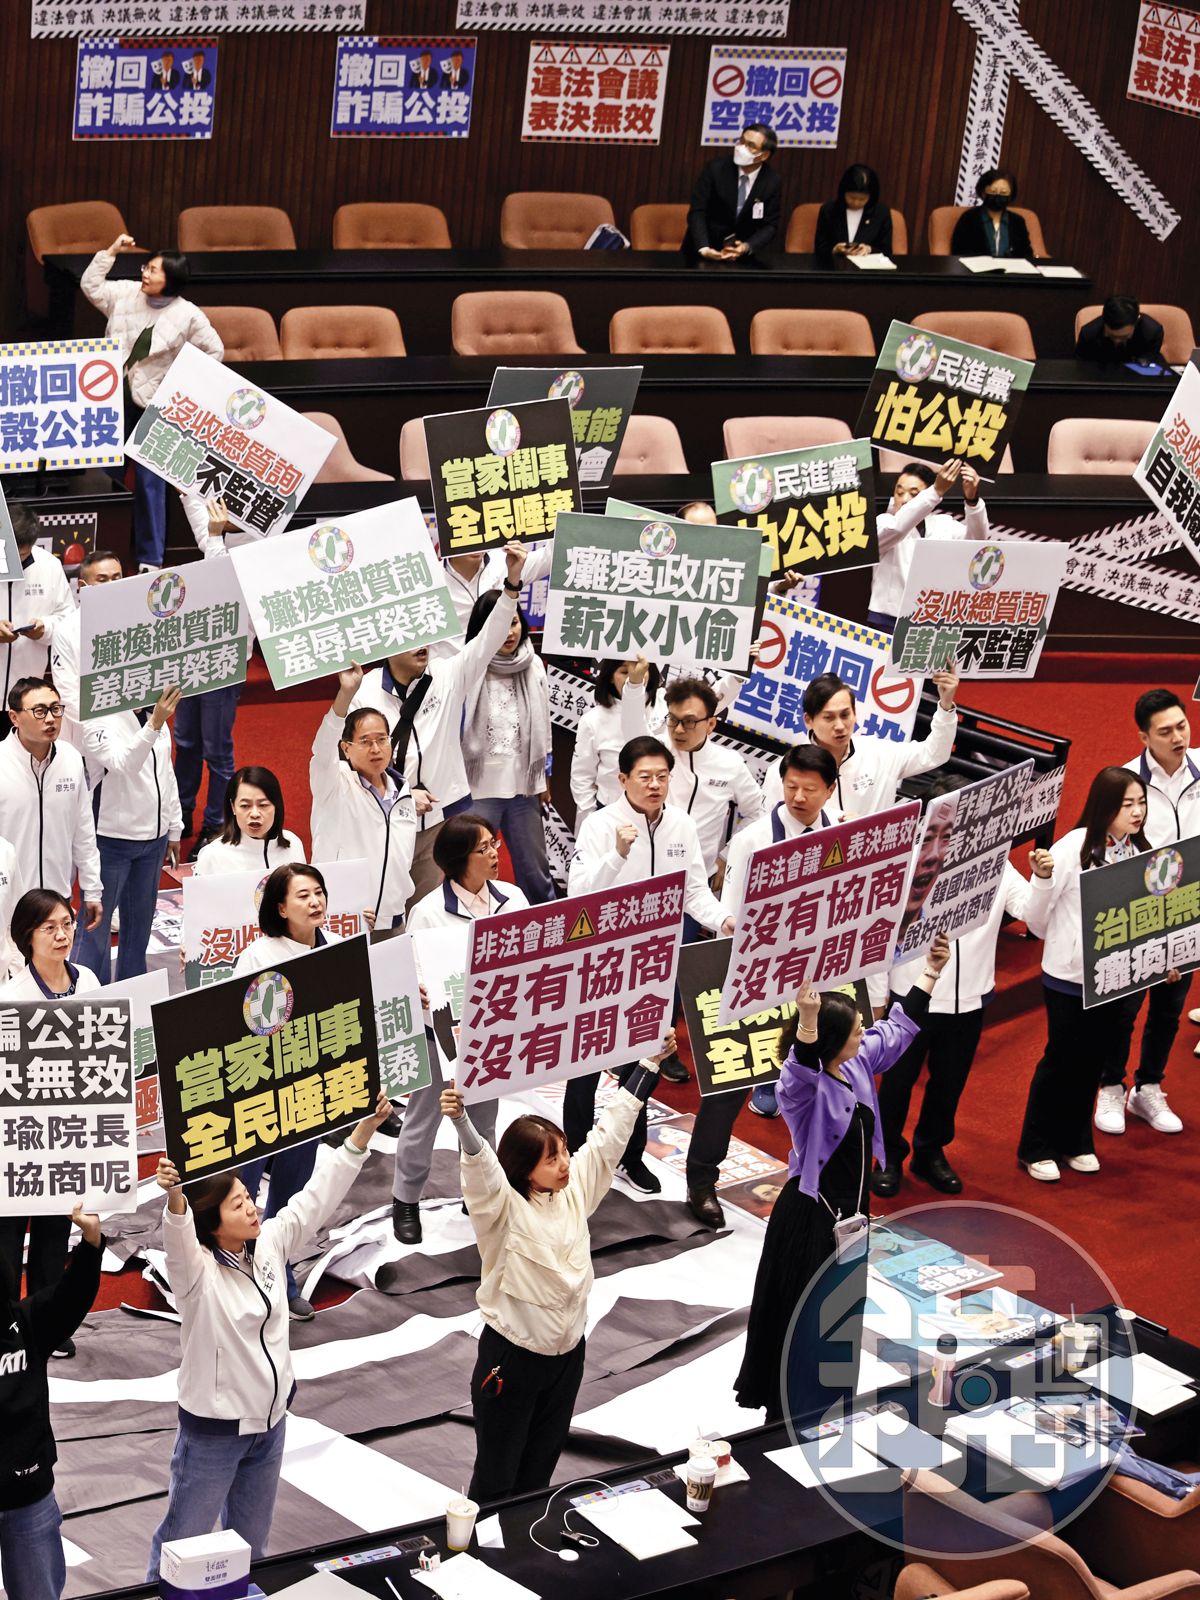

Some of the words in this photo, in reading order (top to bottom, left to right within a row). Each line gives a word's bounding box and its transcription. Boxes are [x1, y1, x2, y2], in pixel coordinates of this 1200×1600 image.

[34, 9, 95, 26] 違法會議
[102, 7, 162, 23] 決議無效
[170, 5, 228, 22] 違法會議
[236, 4, 295, 20] 決議無效
[303, 3, 363, 20] 違法會議
[459, 1, 520, 18] 違法會議
[526, 3, 585, 19] 決議無效
[593, 4, 653, 21] 違法會議
[659, 7, 717, 23] 決議無效
[726, 8, 785, 26] 違法會議
[80, 55, 147, 89] 撤回
[339, 54, 406, 88] 撤回
[531, 67, 659, 98] 違法會議
[745, 66, 810, 97] 撤回
[78, 91, 213, 126] 詐騙公投
[337, 91, 470, 125] 詐騙公投
[528, 101, 655, 135] 表決無效
[709, 101, 837, 134] 空殼公投
[0, 364, 77, 407] 撤回
[929, 348, 1016, 404] 民進黨
[162, 391, 303, 496] 沒收總質詢
[872, 382, 1008, 462] 怕公投
[138, 419, 288, 536] 護航不監督
[441, 444, 569, 502] 當家鬧事
[773, 455, 862, 504] 民進黨
[446, 489, 574, 548] 全民唾棄
[260, 549, 434, 634] 癱瘓總質詢
[563, 546, 746, 603] 癱瘓政府
[1103, 568, 1169, 599] 決議無效
[92, 601, 240, 671] 癱瘓總質詢
[275, 594, 450, 679] 羞辱卓榮泰
[560, 596, 739, 662] 薪水小偷
[911, 590, 1048, 625] 沒收總質詢
[90, 641, 239, 713] 羞辱卓榮泰
[785, 631, 874, 703] 撤回
[898, 627, 1038, 673] 護航不監督
[954, 768, 1034, 829] 詐騙公投
[751, 845, 822, 895] 非法會議
[846, 815, 918, 859] 表決無效
[944, 804, 1022, 867] 表決無效
[739, 862, 908, 956] 沒有協商
[930, 849, 1006, 909] 韓國瑜院長
[474, 913, 566, 966] 非法會議
[597, 884, 683, 935] 表決無效
[903, 888, 996, 954] 說好的協商呢
[469, 933, 676, 1029] 沒有協商
[728, 918, 896, 1012] 沒有開會
[175, 998, 362, 1113] 當家鬧事
[463, 993, 669, 1089] 沒有開會
[181, 1057, 370, 1172] 全民唾棄
